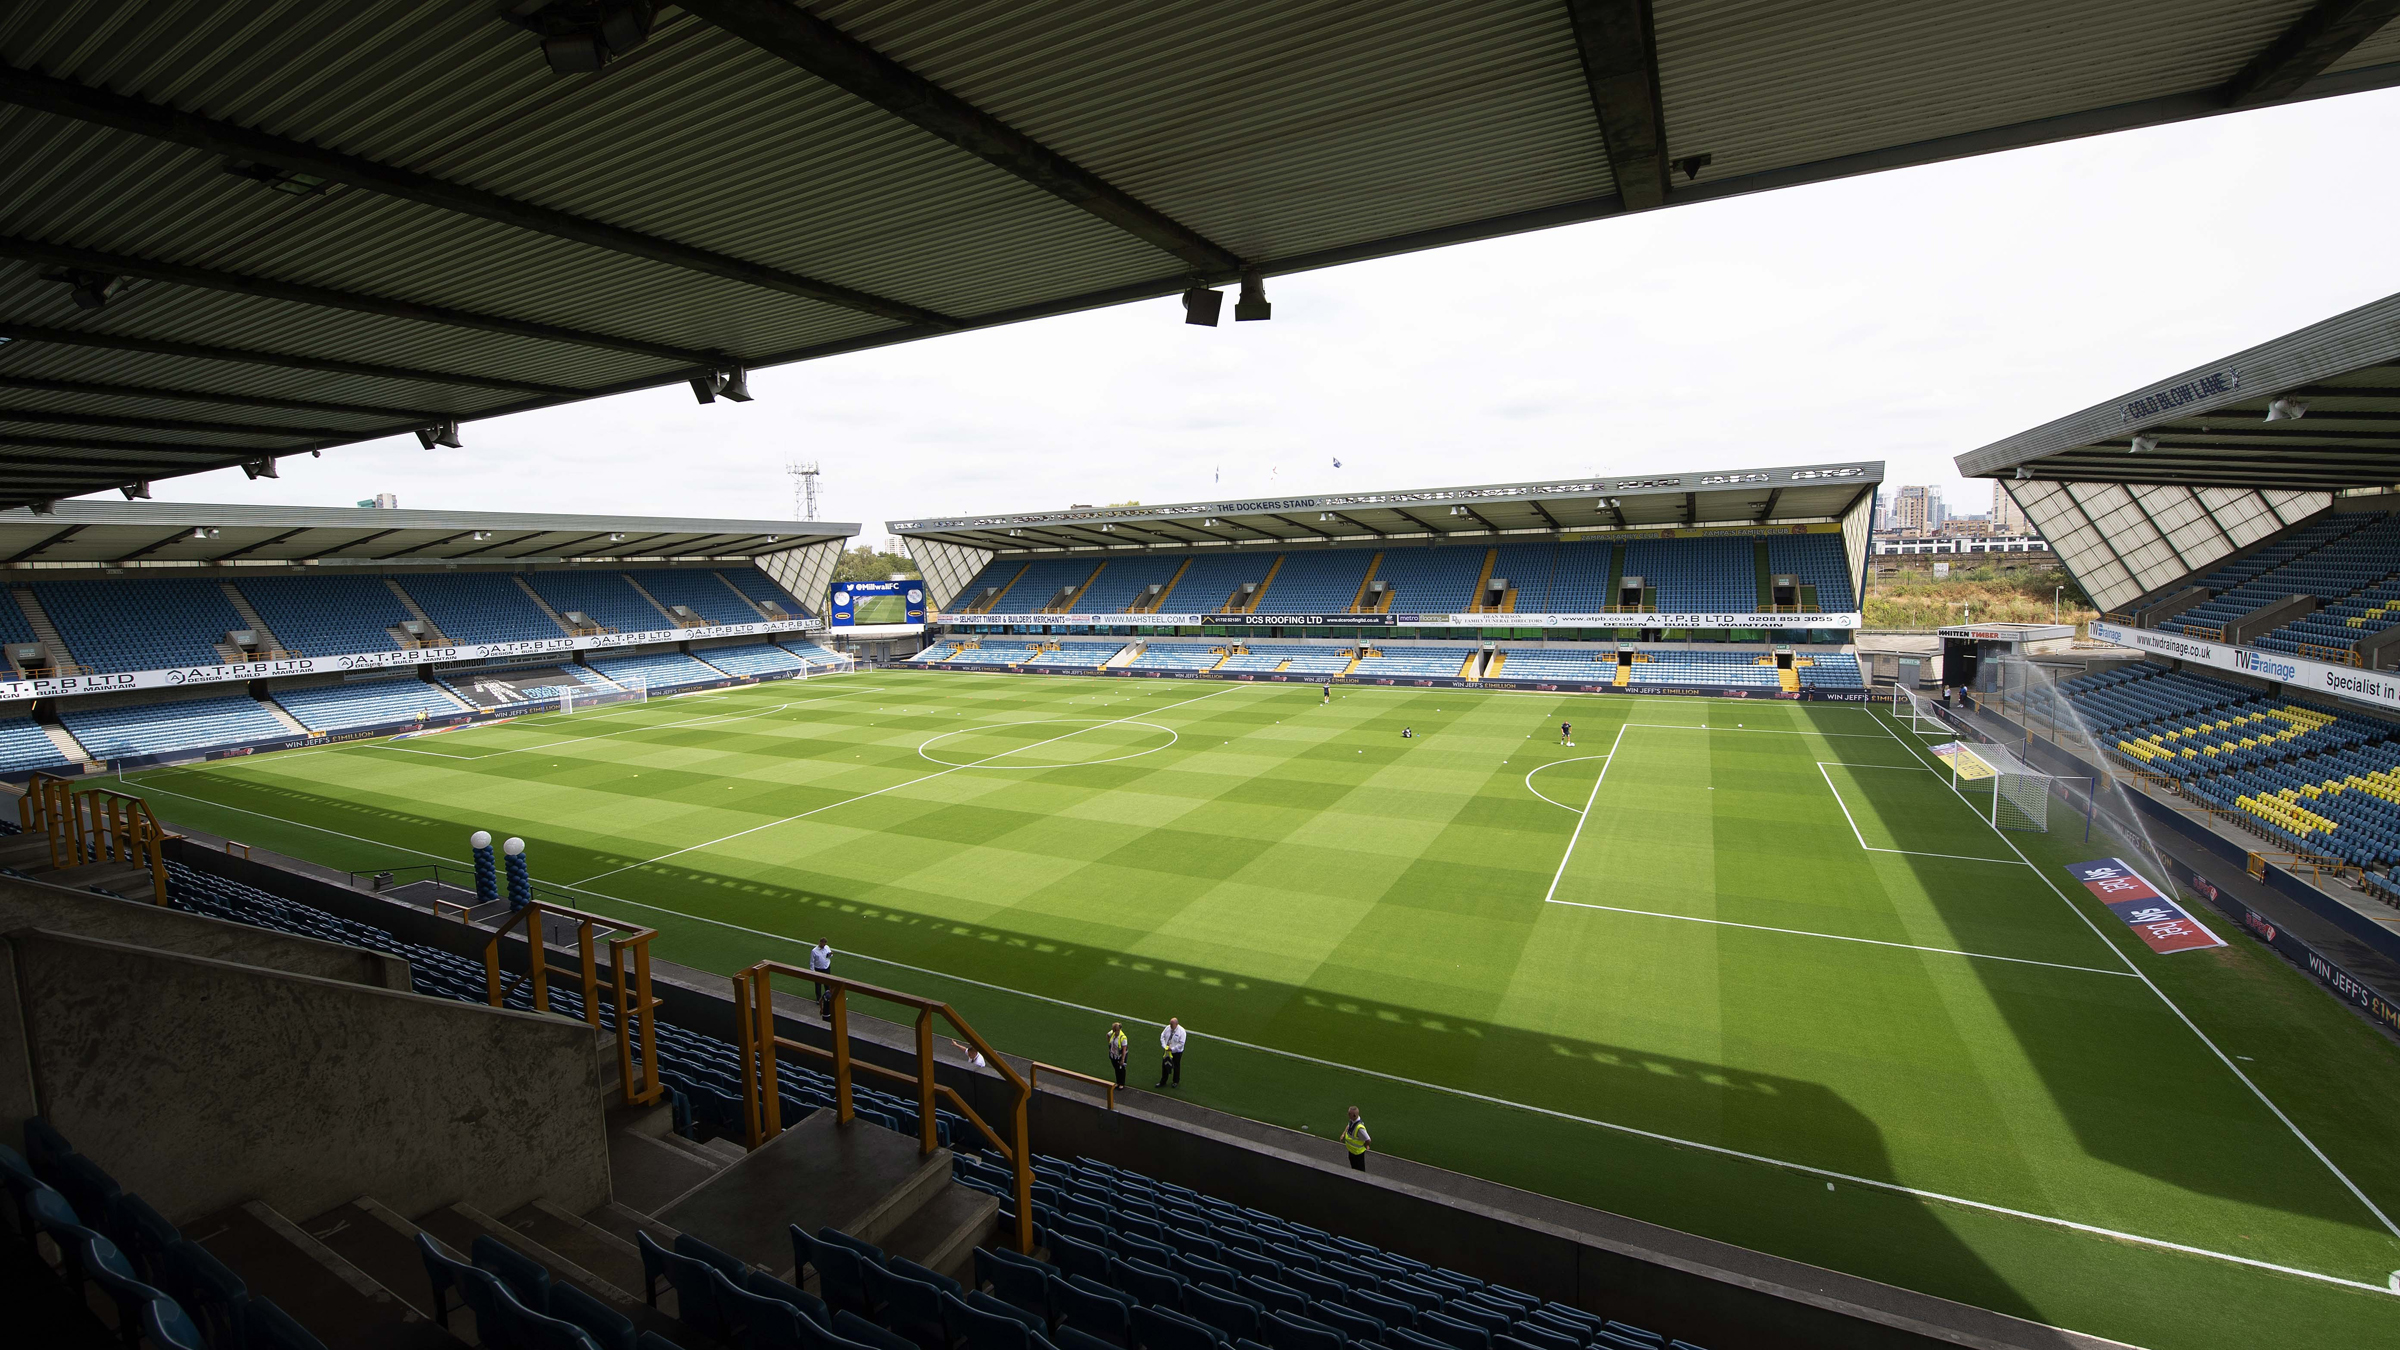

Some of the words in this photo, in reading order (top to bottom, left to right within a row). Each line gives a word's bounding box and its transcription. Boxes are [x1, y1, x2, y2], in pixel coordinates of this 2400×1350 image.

[2127, 396, 2160, 419] COLD
[2155, 384, 2195, 410] BLOW
[2190, 372, 2231, 400] LANE
[1217, 503, 1235, 512] THE
[1237, 501, 1281, 511] DOCKERS
[1283, 499, 1315, 509] STAND
[855, 583, 899, 591] @MillwallFC
[959, 615, 982, 623] SELHURST
[982, 615, 1002, 623] TIMBER
[1033, 616, 1065, 624] MERCHANTS
[1104, 616, 1186, 624] WWW.MAHSTEEL.COM
[1245, 616, 1264, 624] DCS
[1265, 616, 1305, 624] ROOFING
[1306, 616, 1323, 624] LTD
[695, 627, 732, 635] A.T.P.B
[602, 633, 646, 643] A.T.P.B
[490, 642, 543, 652] A.T.P.B
[548, 640, 574, 648] LTD
[2136, 634, 2211, 660] www.twdrainage.co.uk
[355, 650, 420, 663] A.T.P.B
[421, 649, 456, 658] LTD
[188, 663, 267, 677] A.T.P.B
[275, 660, 313, 671] LTD
[88, 674, 135, 686] LTD
[2326, 671, 2381, 697] Specialist
[2383, 683, 2395, 700] in
[84, 683, 136, 692] MAINTAIN
[509, 709, 528, 717] JEFF'S
[285, 741, 303, 749] WIN
[304, 737, 330, 746] JEFF'S
[331, 731, 374, 743] £1MILLION
[2083, 867, 2122, 881] sky
[2098, 876, 2138, 893] bet
[2129, 907, 2173, 923] sky
[2146, 919, 2193, 939] bet
[2308, 952, 2331, 980] WIN
[2332, 971, 2368, 1007] JEFF'S
